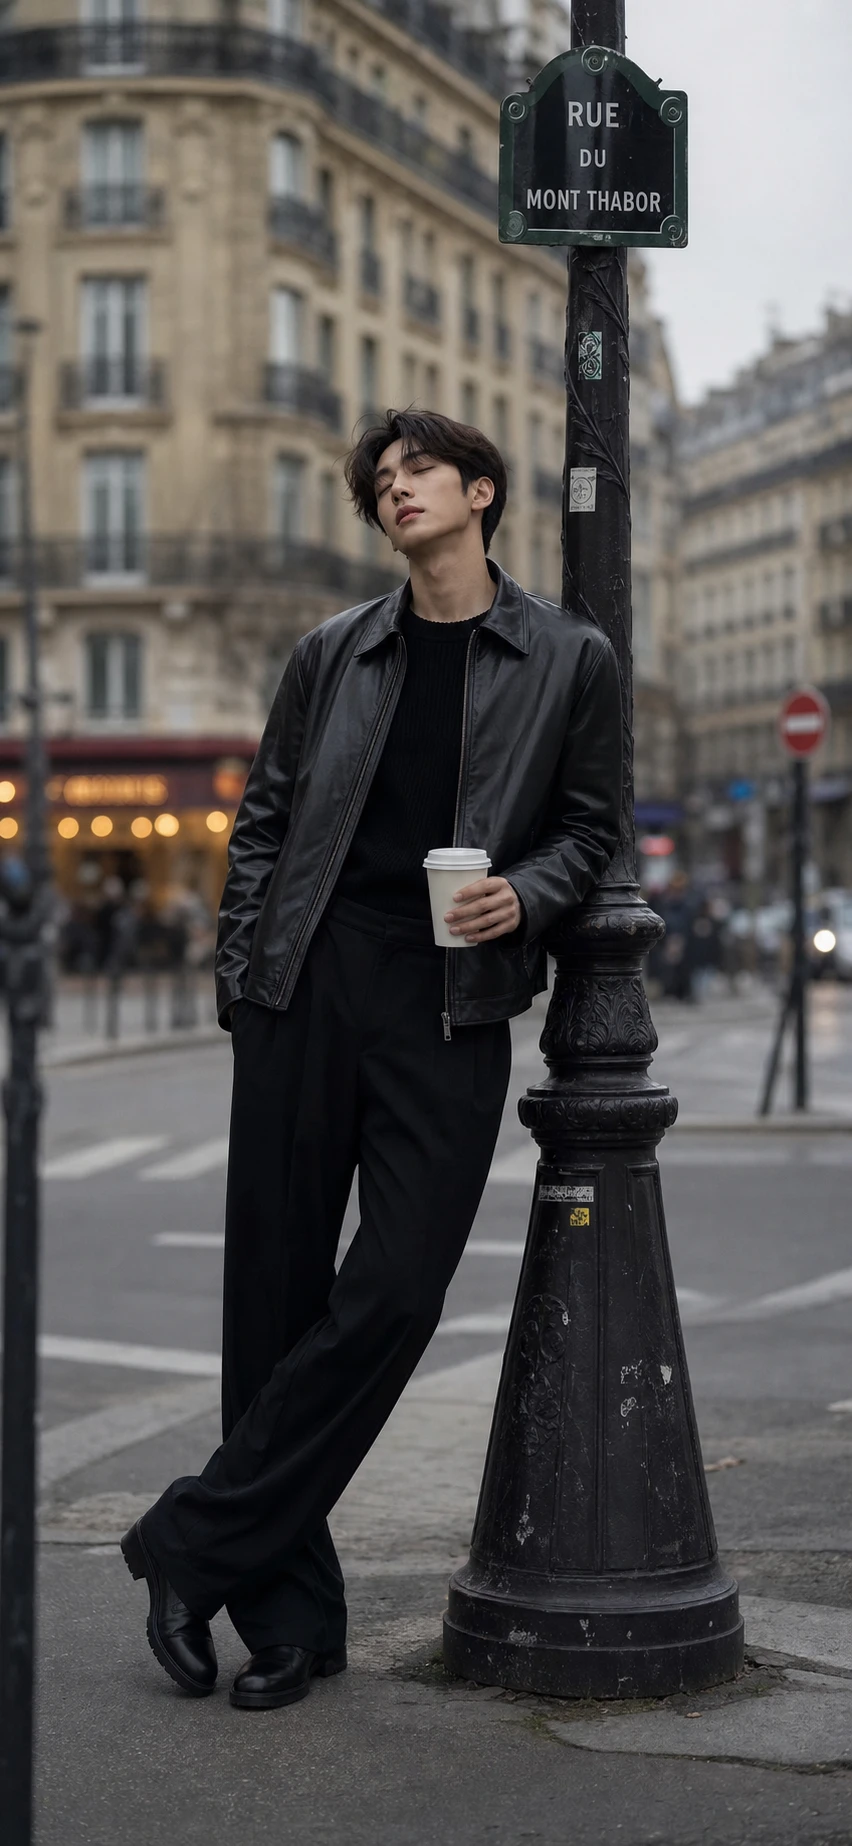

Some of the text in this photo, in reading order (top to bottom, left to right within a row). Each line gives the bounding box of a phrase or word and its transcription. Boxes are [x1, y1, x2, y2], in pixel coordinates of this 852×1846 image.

[568, 101, 620, 128] RUE
[580, 149, 606, 168] DU
[527, 189, 661, 212] MONT THABOR
